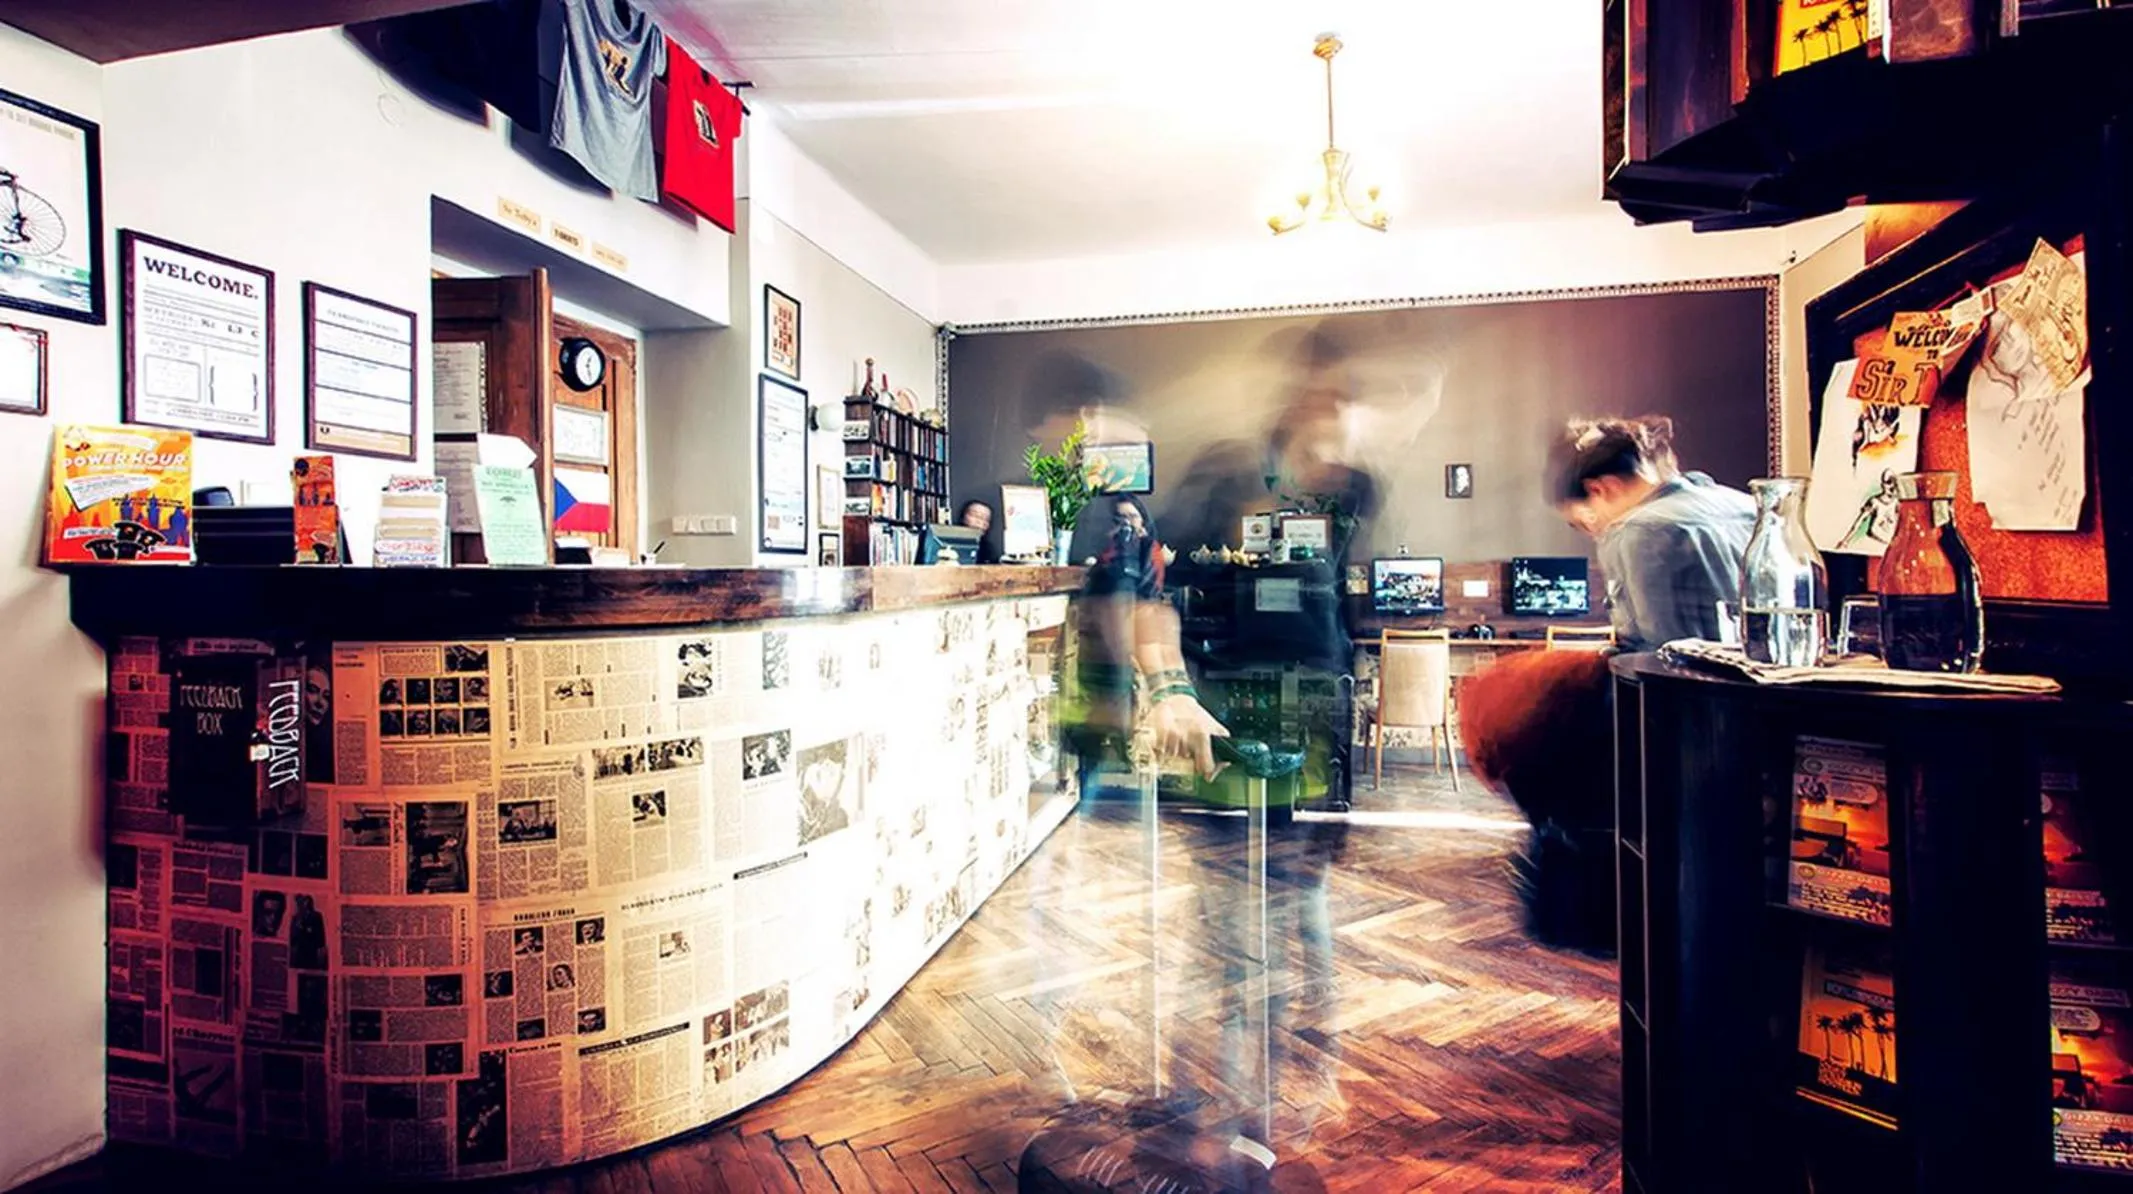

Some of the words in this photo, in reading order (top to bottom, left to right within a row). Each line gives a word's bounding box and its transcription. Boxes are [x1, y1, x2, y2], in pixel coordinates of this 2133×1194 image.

[143, 256, 259, 300] WELCOME.
[131, 451, 189, 467] HOUR
[196, 711, 224, 736] BOX
[267, 679, 300, 789] FEEDBACK
